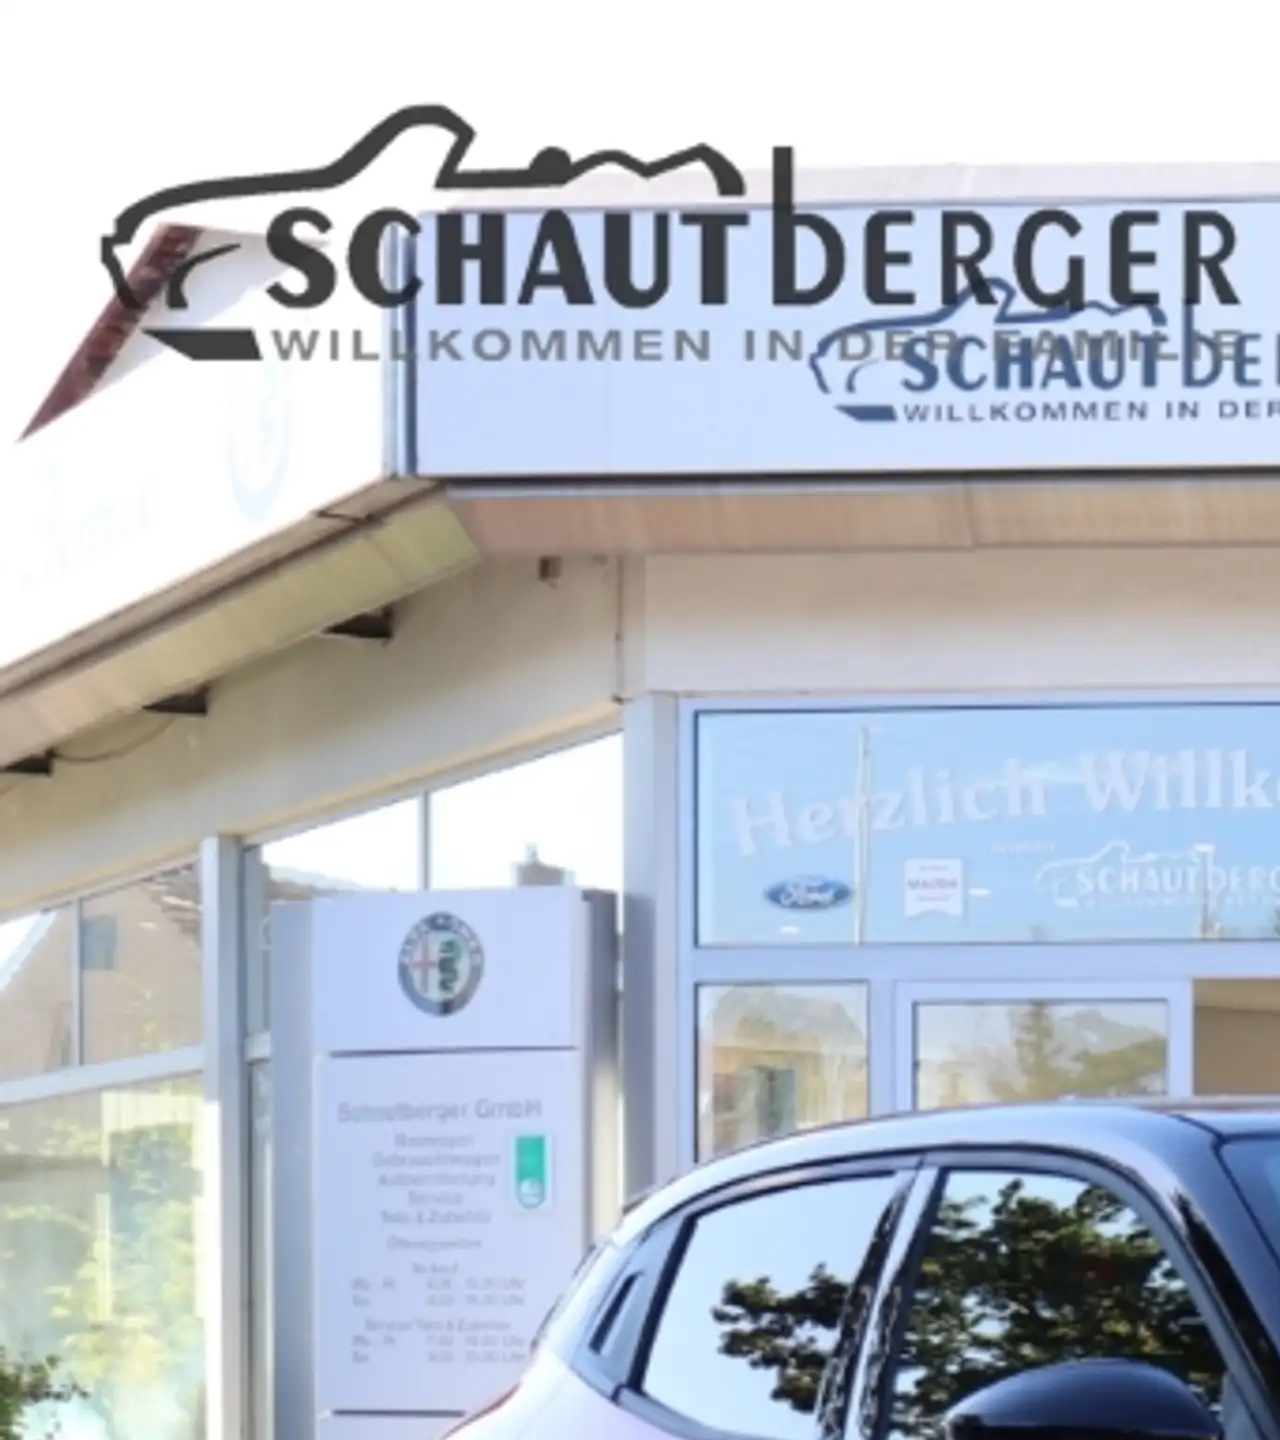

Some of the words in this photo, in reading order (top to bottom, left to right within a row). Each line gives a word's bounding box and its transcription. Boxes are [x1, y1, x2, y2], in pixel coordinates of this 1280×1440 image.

[903, 401, 1146, 421] WILLKOMMEN
[1166, 400, 1200, 419] IN
[732, 757, 1048, 856] Herzlich
